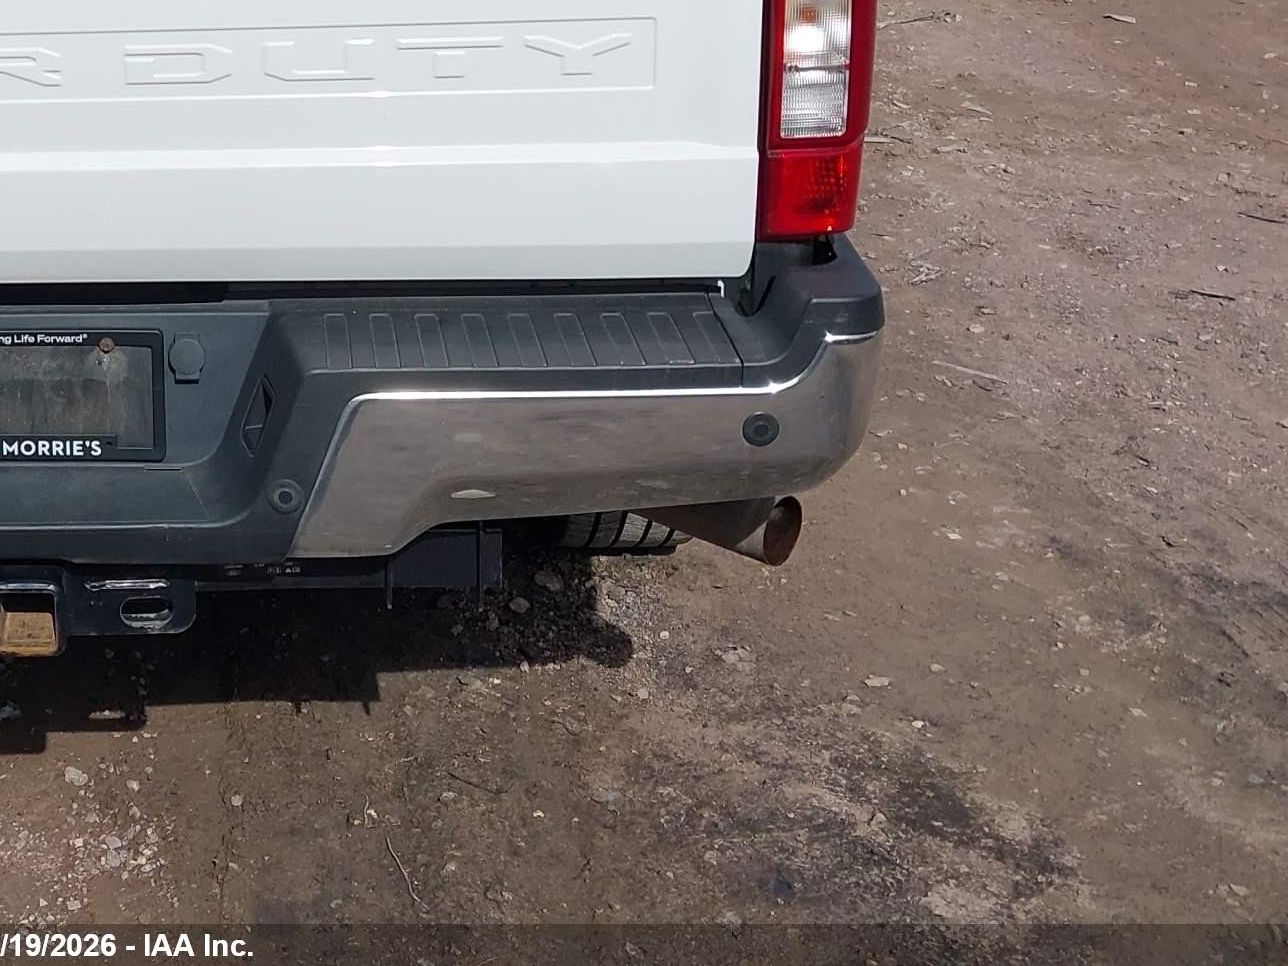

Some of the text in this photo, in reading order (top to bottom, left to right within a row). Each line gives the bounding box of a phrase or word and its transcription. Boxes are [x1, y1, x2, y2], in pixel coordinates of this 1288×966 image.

[123, 32, 632, 86] DUTY
[14, 334, 35, 343] Life
[2, 440, 102, 456] MORRIE'S
